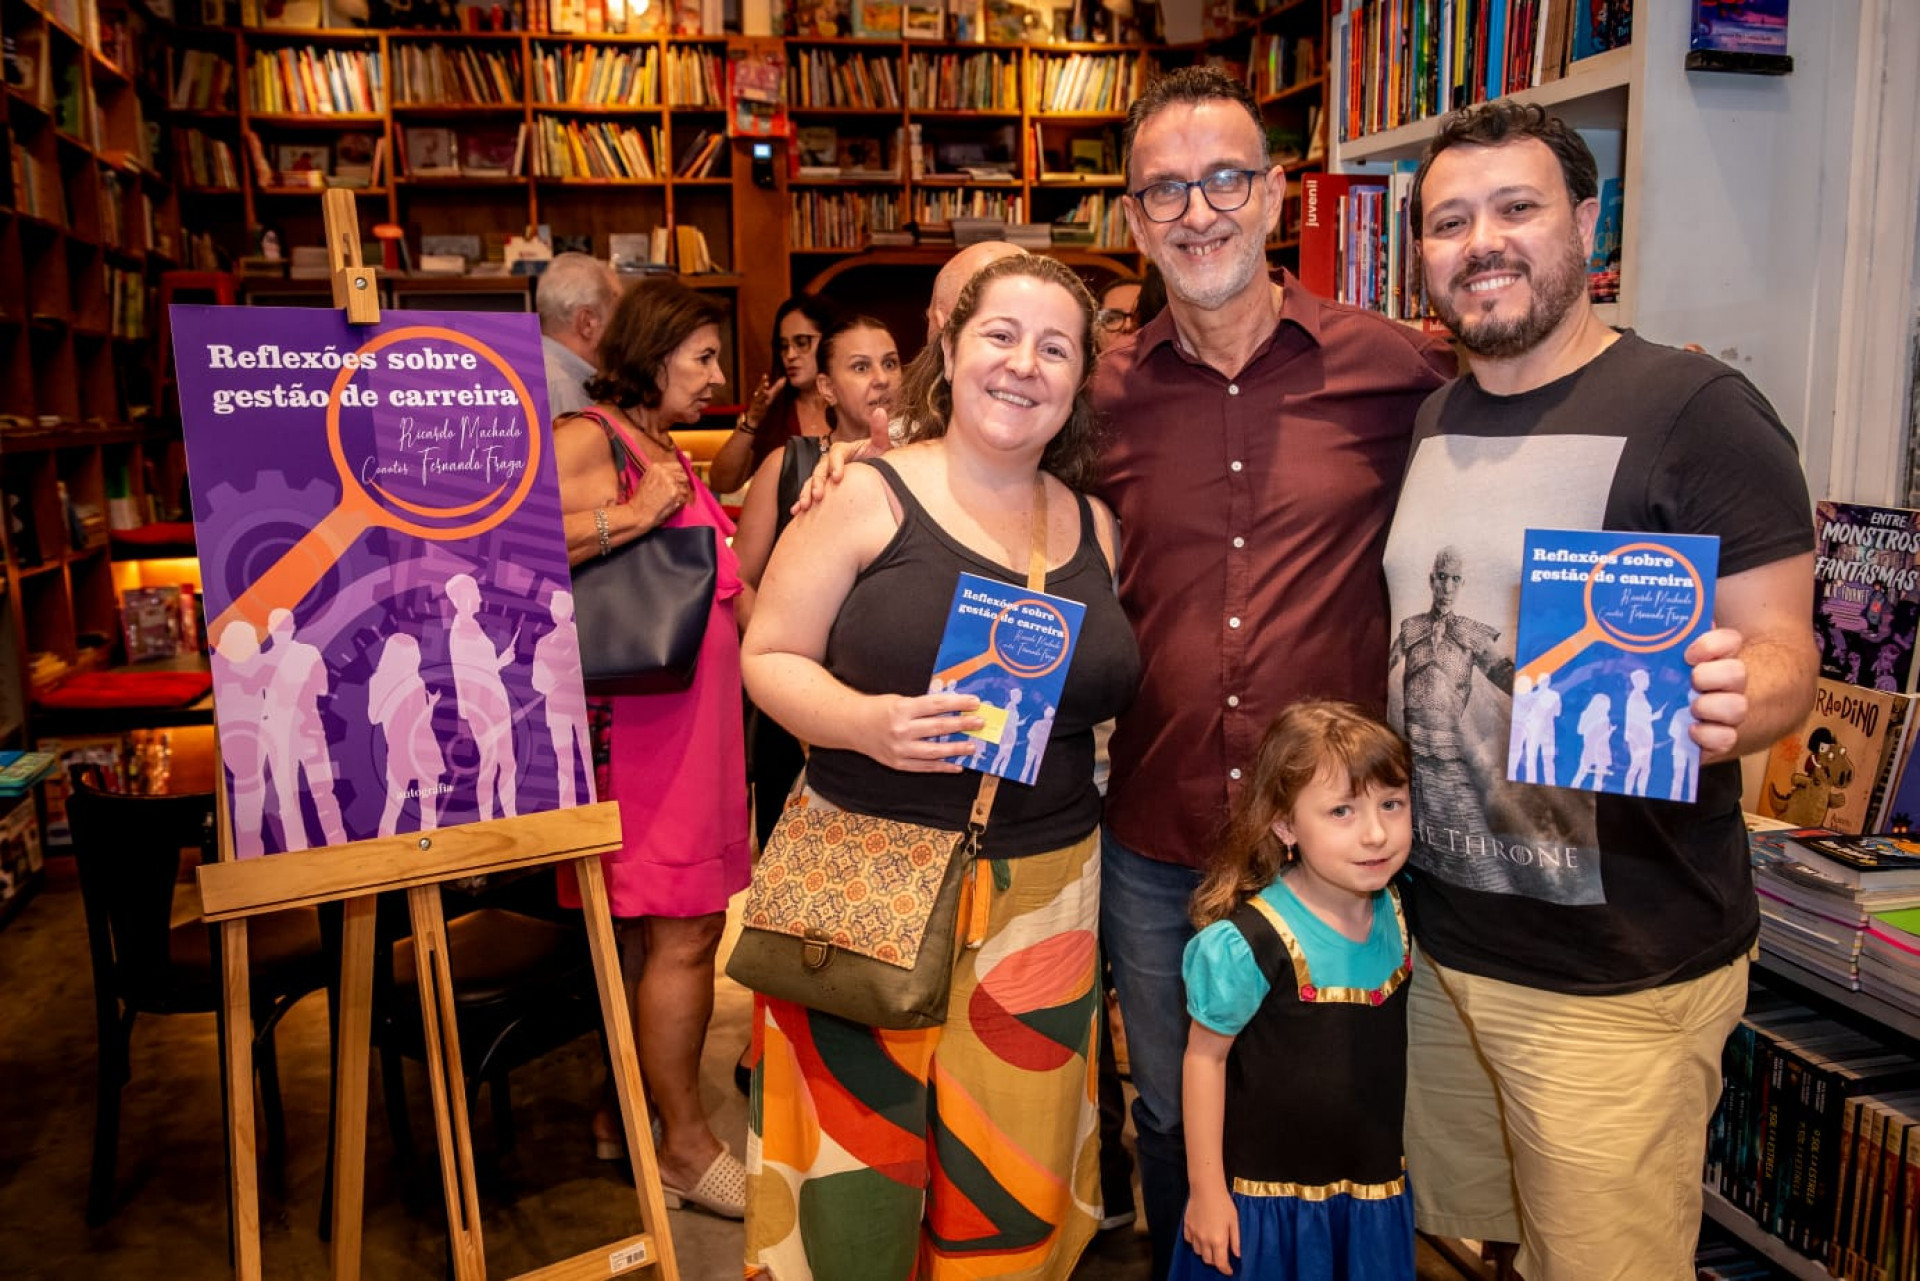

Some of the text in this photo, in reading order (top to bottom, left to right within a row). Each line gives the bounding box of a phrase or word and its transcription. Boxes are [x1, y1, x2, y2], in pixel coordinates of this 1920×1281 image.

[1306, 180, 1319, 227] juvenil
[207, 344, 477, 370] Reflexões sobre
[213, 382, 519, 415] gestão de carreira
[400, 415, 522, 451] Ricardo Machado
[418, 446, 483, 487] Fernando
[482, 445, 524, 484] Fraga
[1870, 512, 1908, 528] ENTRE
[1822, 521, 1920, 554] MONSTROS
[1532, 547, 1674, 567] Reflexões sobre
[1815, 555, 1918, 591] FANTASMAS
[1531, 568, 1695, 588] gestão de carreira
[958, 603, 1065, 638] gestão de carreira
[962, 587, 1055, 621] Reflexões sobre
[1443, 827, 1579, 868] THRONE
